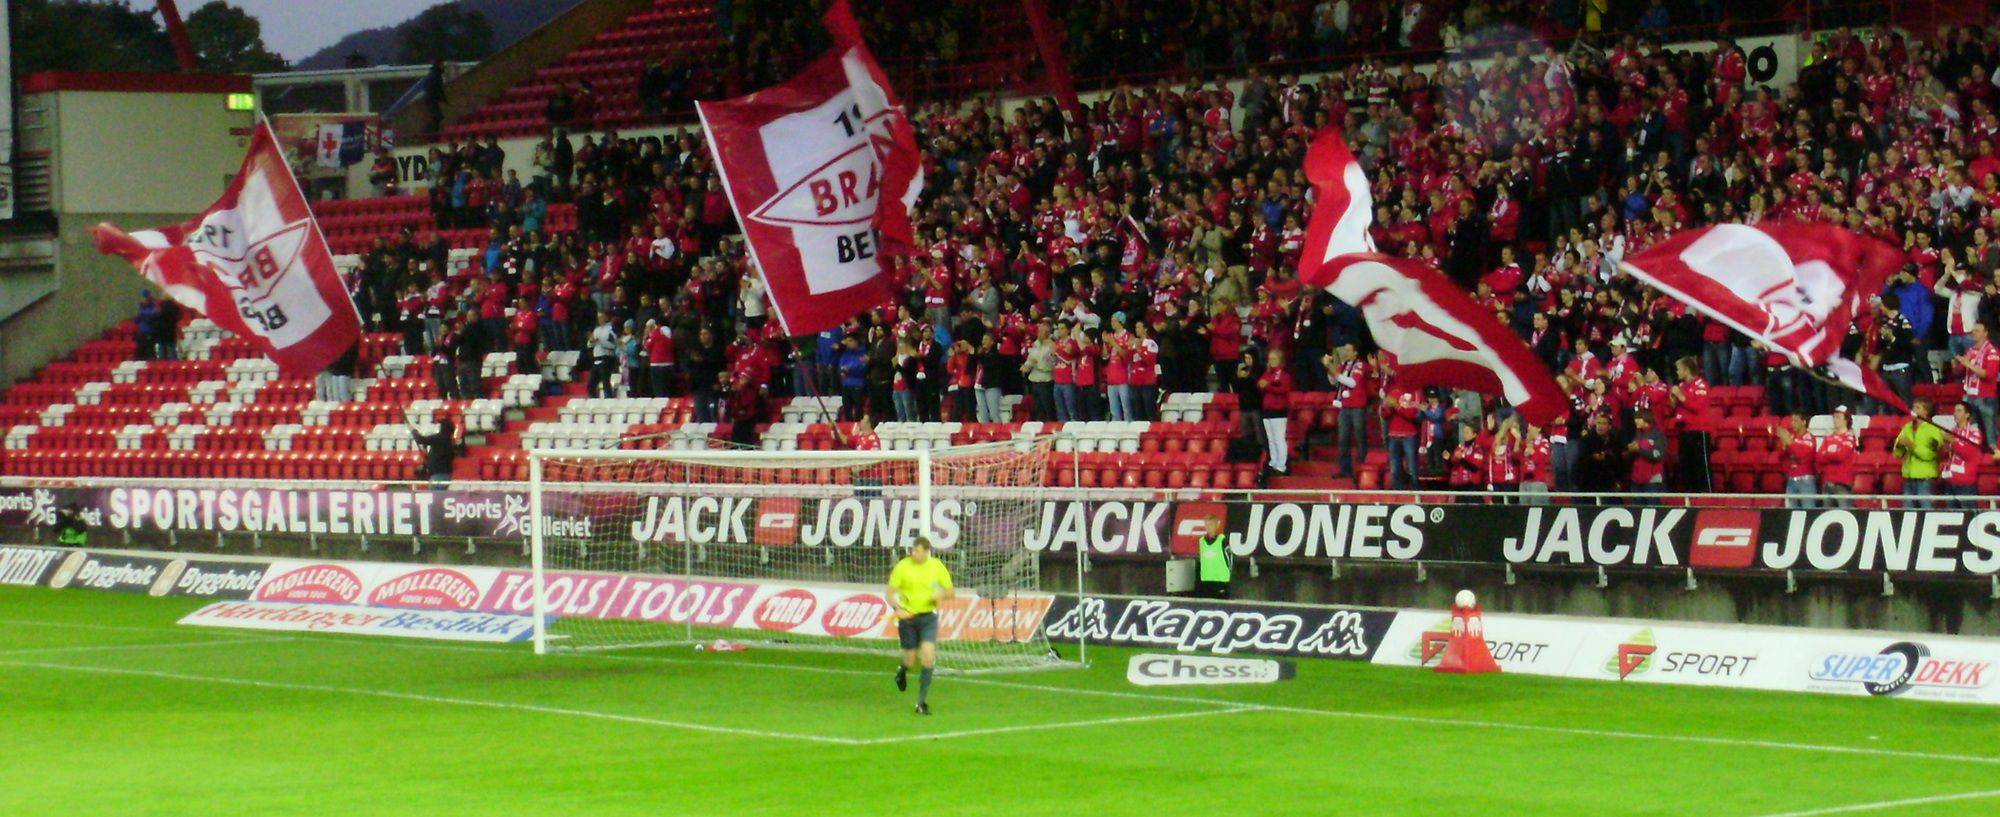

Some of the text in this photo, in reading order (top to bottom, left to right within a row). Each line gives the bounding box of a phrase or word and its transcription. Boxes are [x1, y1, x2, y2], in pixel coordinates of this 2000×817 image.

[110, 487, 433, 535] SPORTSGALLERIET
[443, 498, 502, 523] Sports
[632, 496, 752, 542] JACK
[519, 515, 592, 537] Glleriet
[1024, 501, 1169, 553] JACK
[1503, 507, 2000, 574] JACK JONES
[78, 560, 156, 588] Byggholt
[178, 567, 261, 595] Byggholt
[264, 568, 359, 599] MØLLERENS
[375, 572, 476, 607] MØLLERENS
[494, 575, 607, 614] TOOLS
[621, 582, 743, 624] TOOLS
[760, 597, 814, 623] TORO
[828, 602, 882, 628] TORO
[970, 609, 1039, 628] OKTAN
[1111, 600, 1302, 653] Kappa
[1485, 640, 1549, 663] PORT
[1661, 652, 1757, 677] SPORT
[1138, 659, 1251, 678] Chess
[1815, 654, 1990, 686] SUPER DEKK
